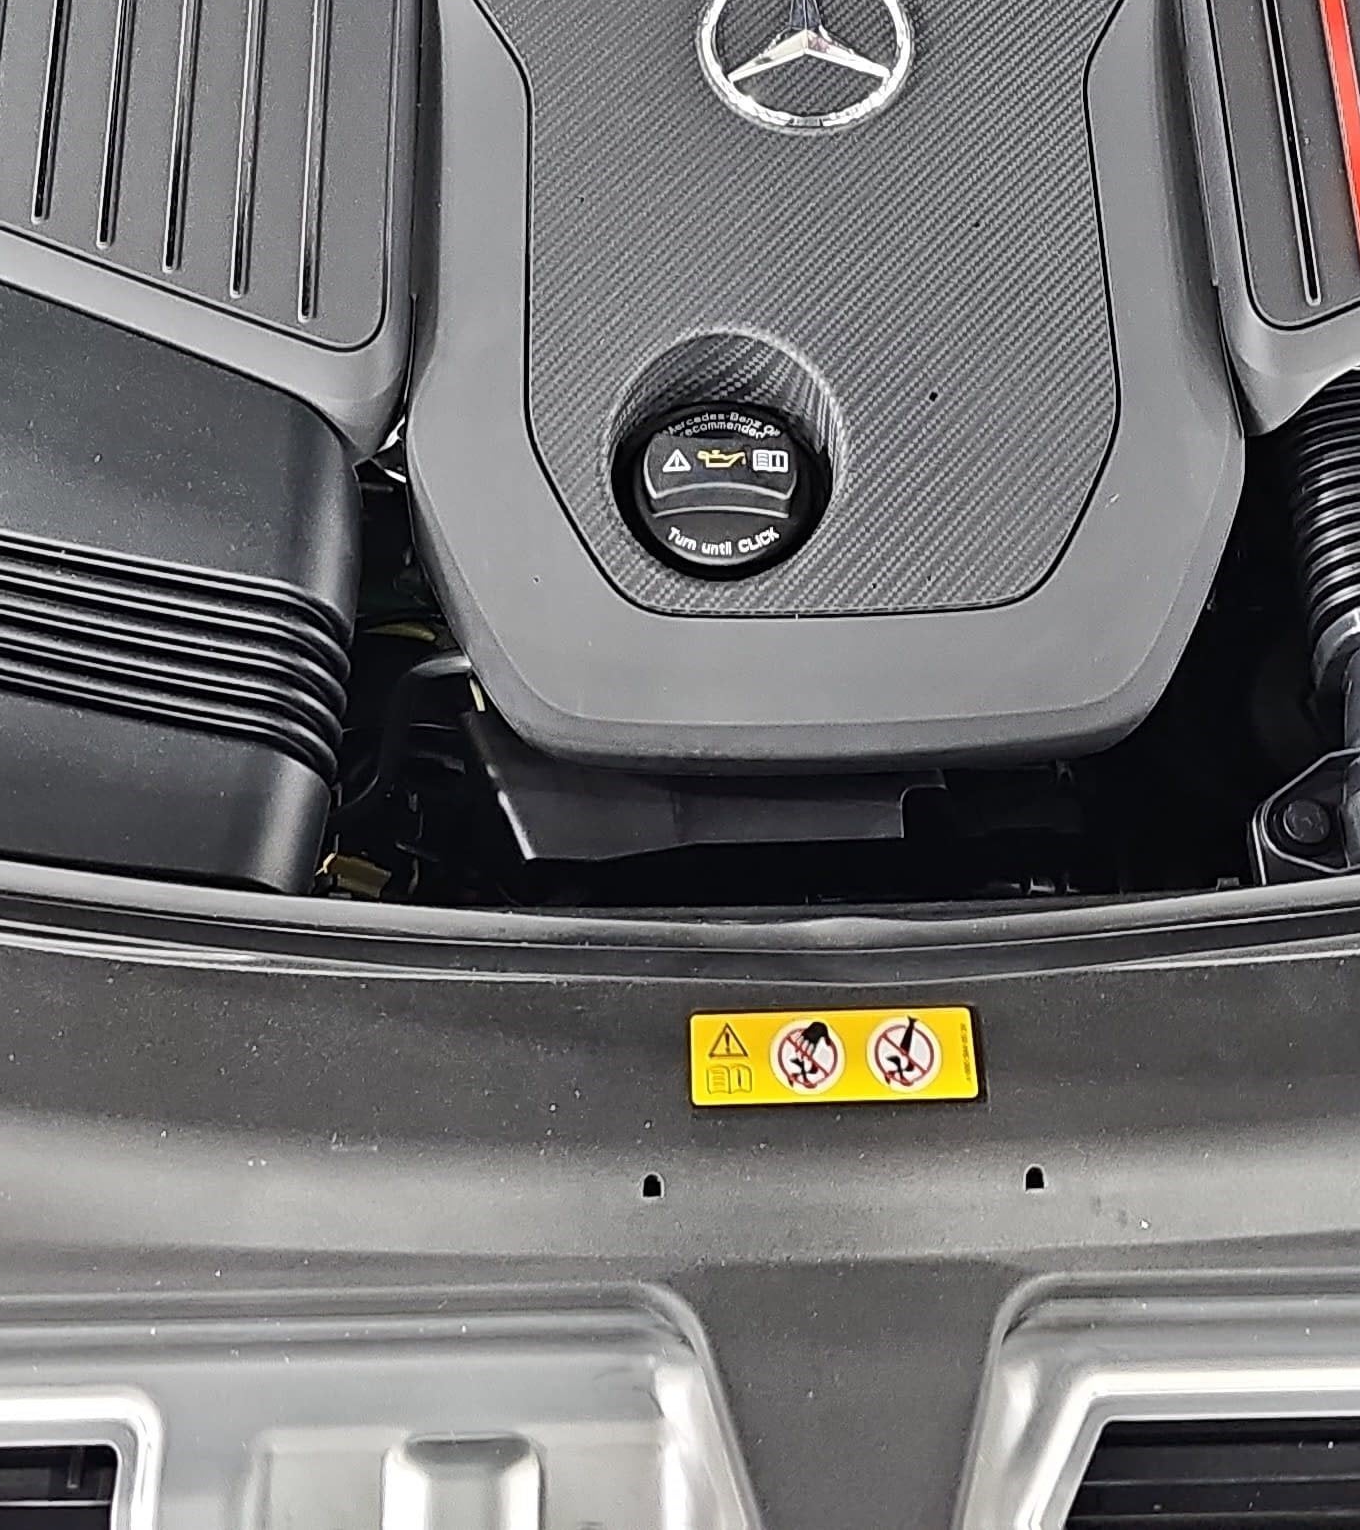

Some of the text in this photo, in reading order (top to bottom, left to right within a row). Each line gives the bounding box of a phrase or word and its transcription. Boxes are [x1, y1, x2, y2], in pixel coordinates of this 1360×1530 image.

[667, 526, 780, 556] Turn until CLICK
